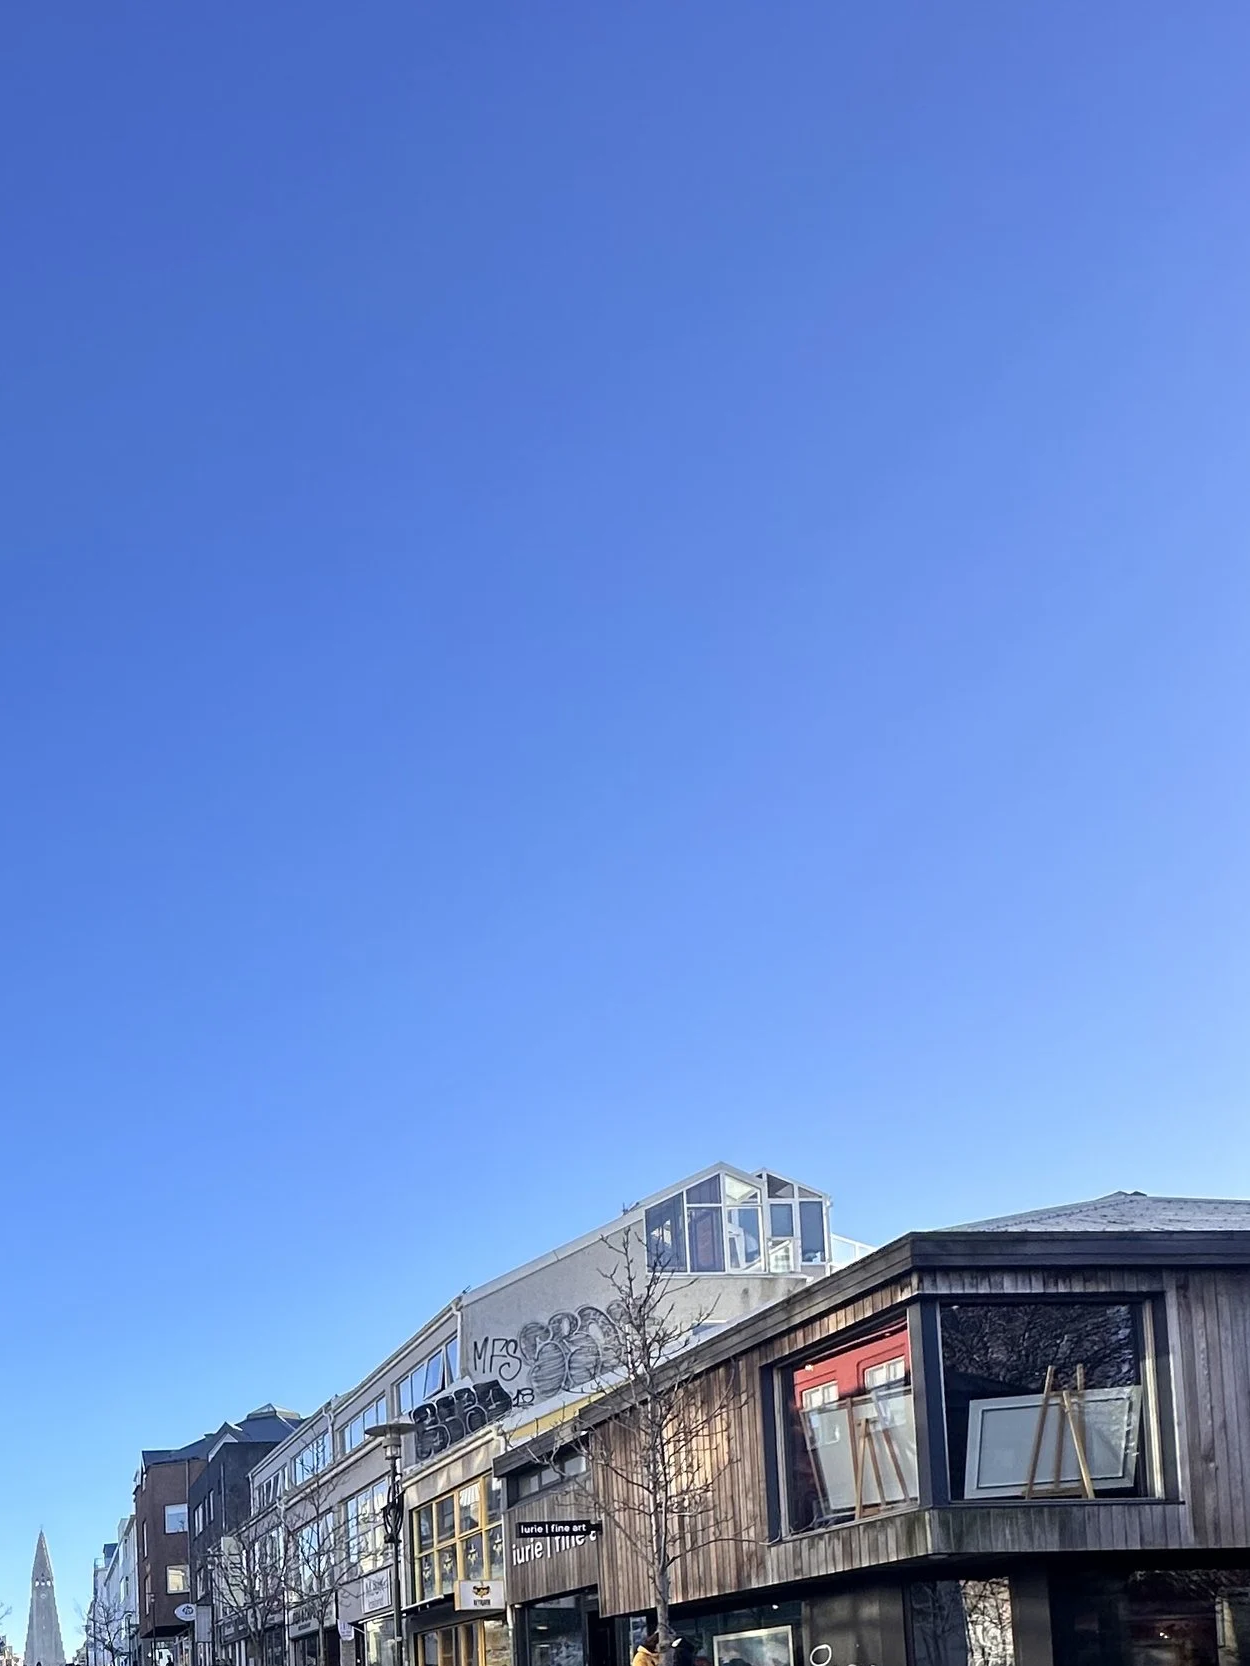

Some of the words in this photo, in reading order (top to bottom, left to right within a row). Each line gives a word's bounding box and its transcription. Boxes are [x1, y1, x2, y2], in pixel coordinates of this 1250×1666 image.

[550, 1524, 570, 1533] fine
[572, 1523, 587, 1532] art
[512, 1537, 543, 1566] iurie
